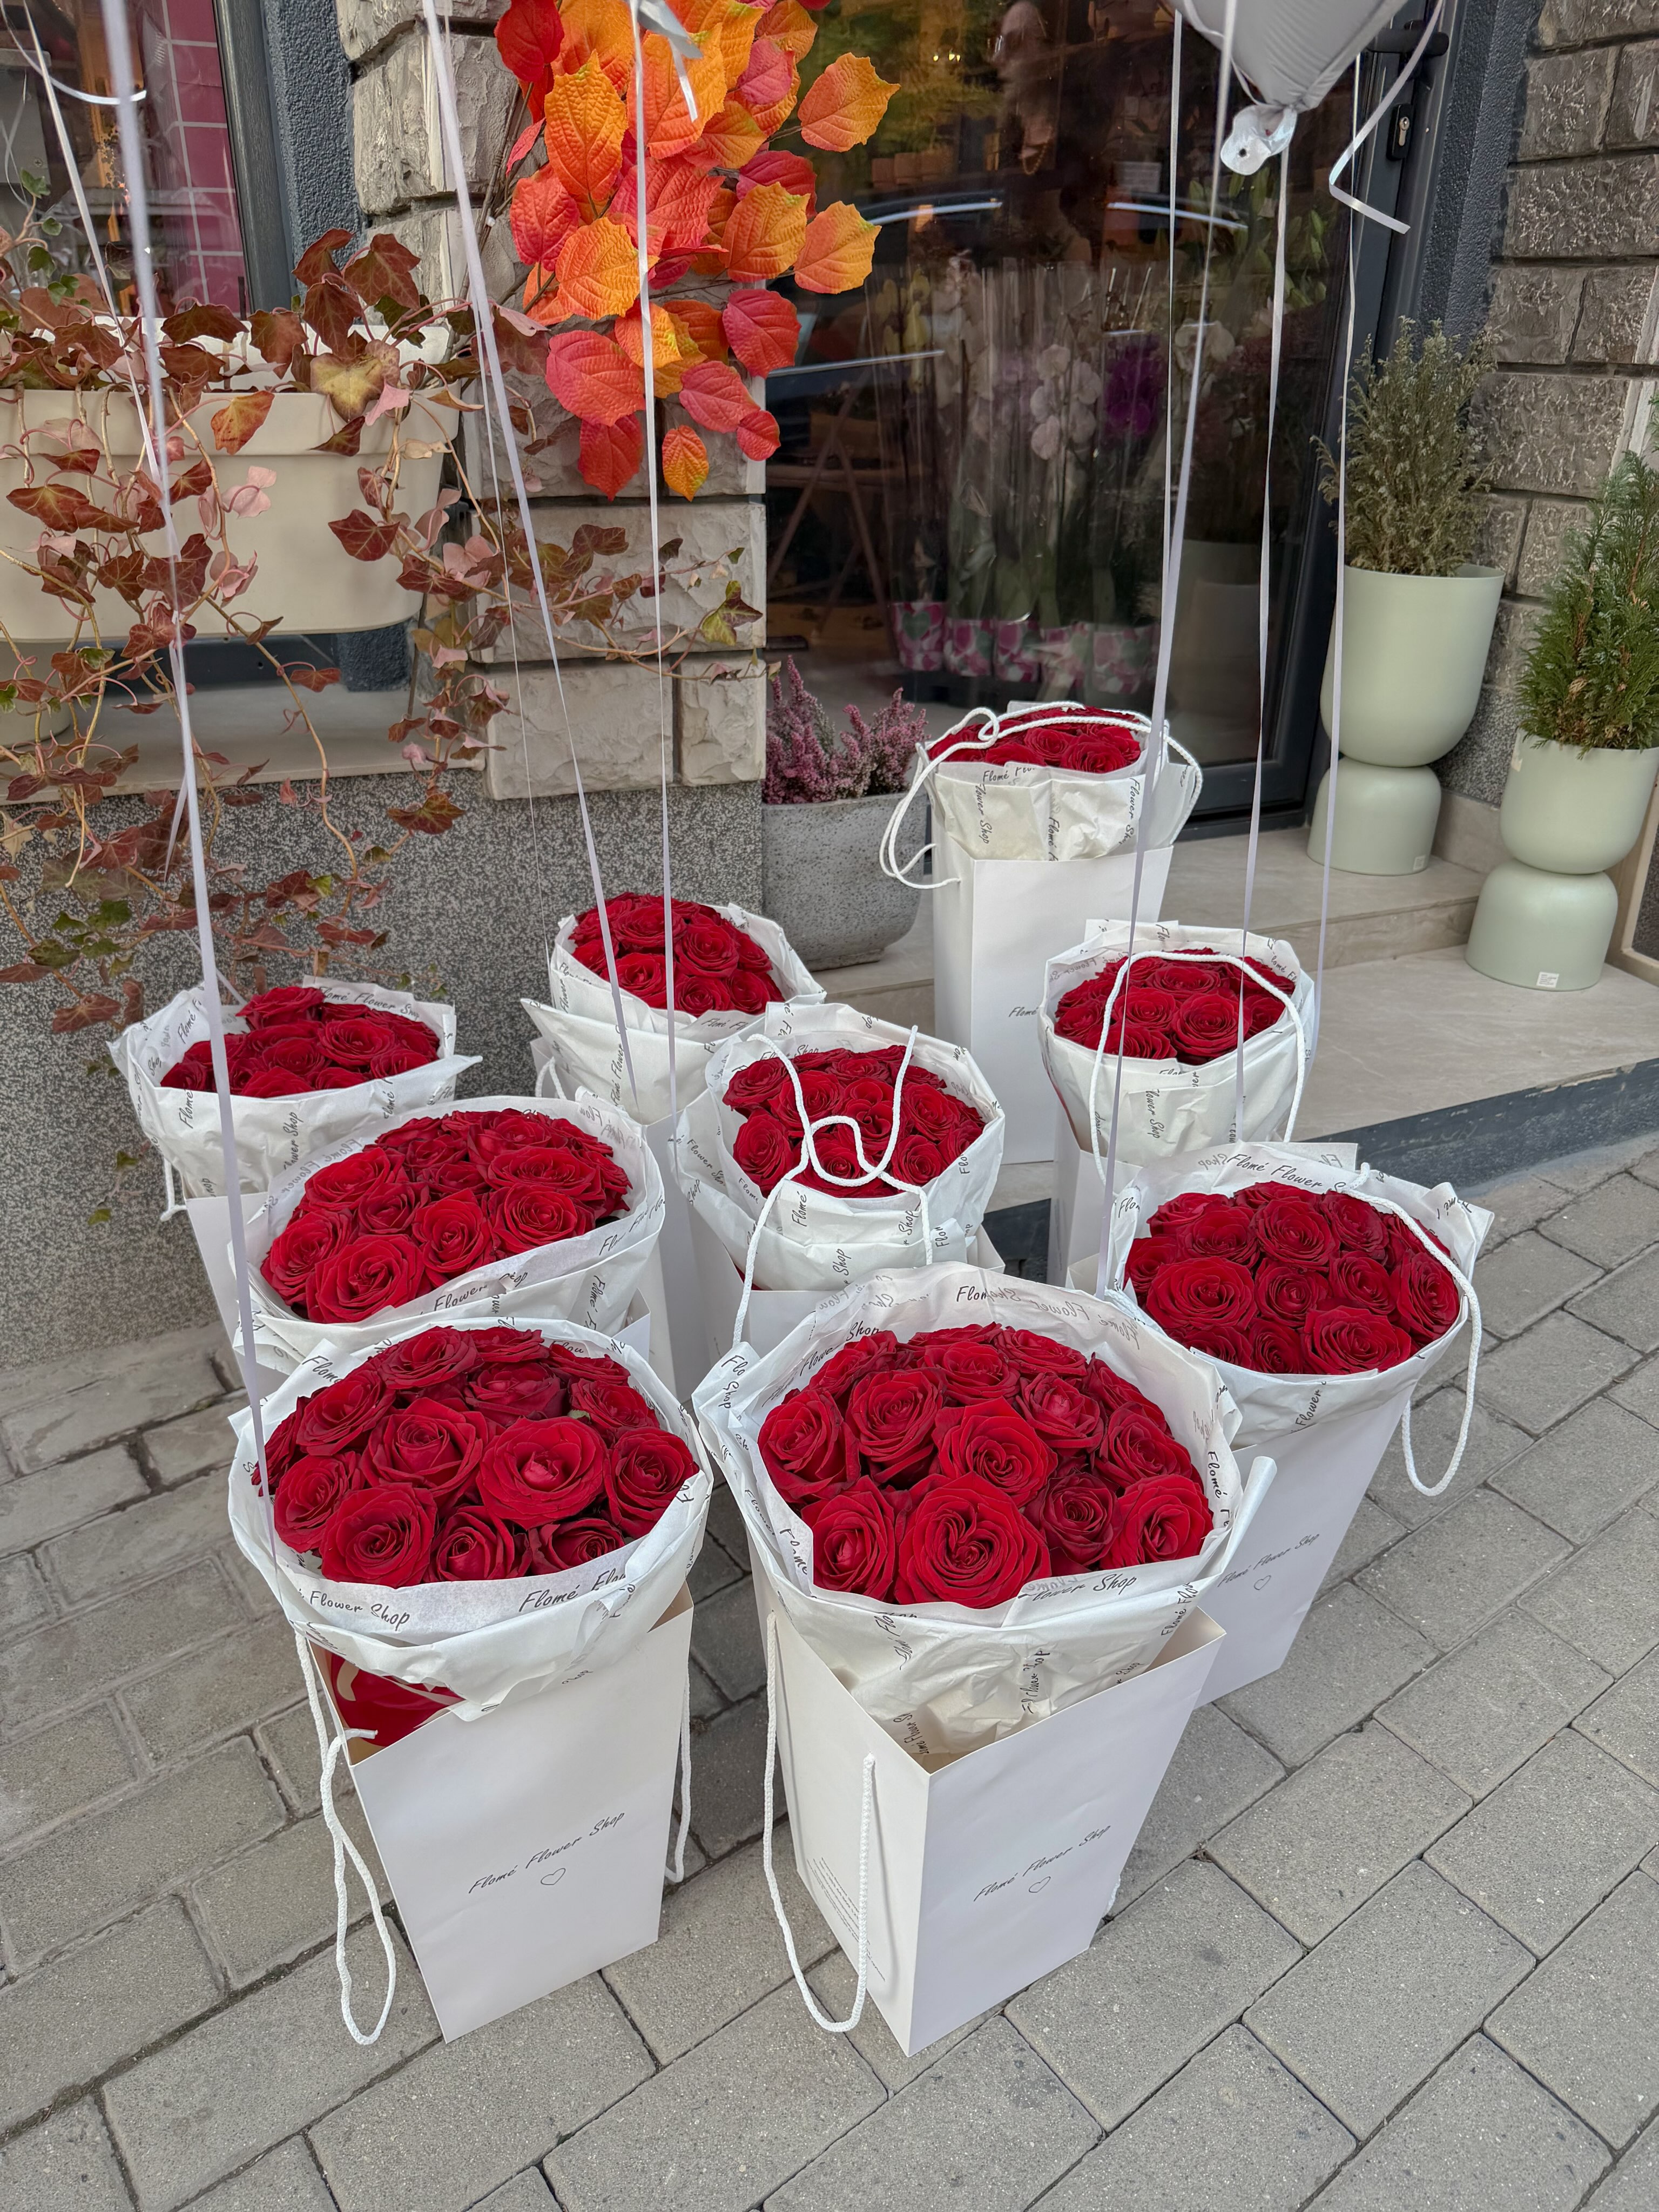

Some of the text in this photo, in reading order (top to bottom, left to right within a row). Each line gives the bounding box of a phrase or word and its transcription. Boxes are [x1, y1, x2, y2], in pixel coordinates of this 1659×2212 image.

[983, 770, 1009, 783] Flomé
[1130, 778, 1141, 819] Flower
[979, 820, 992, 844] Shop
[1048, 817, 1060, 848] Flomé
[1156, 924, 1170, 942] Flo
[1271, 954, 1287, 973] lomé
[354, 993, 397, 1010] Flower
[401, 1003, 421, 1021] Shop
[559, 979, 569, 1013] Flower
[1008, 1006, 1040, 1017] Flomé
[178, 1010, 196, 1044] Flomé
[179, 1088, 194, 1129] Flomé
[283, 1111, 305, 1137] Shop
[1147, 1118, 1164, 1139] Shop
[687, 1138, 714, 1170] Flower
[959, 1154, 970, 1175] Flo
[1227, 1154, 1270, 1171] Flomé
[1271, 1165, 1323, 1188] Flower
[202, 1177, 217, 1197] hop
[792, 1191, 807, 1227] Flomé
[1118, 1197, 1140, 1218] Flo
[899, 1210, 920, 1236] Shop
[935, 1226, 949, 1247] Flo
[833, 1249, 852, 1276] Shop
[434, 1285, 488, 1312] Flower
[590, 1275, 606, 1313] Flomé
[721, 1354, 748, 1377] Flo
[718, 1380, 739, 1409] Shop
[1295, 1389, 1320, 1427] Flower
[1208, 1451, 1228, 1499] Flomé
[1217, 1534, 1320, 1587] Flomé Flower Shop
[518, 1584, 580, 1613] Flomé
[1092, 1573, 1137, 1596] Shop
[309, 1590, 410, 1631] Flower Shop
[1161, 1608, 1186, 1636] Flomé
[468, 1812, 625, 1894] Flomé Flower Shop
[973, 1825, 1111, 1902] Flomé Flower Shop
